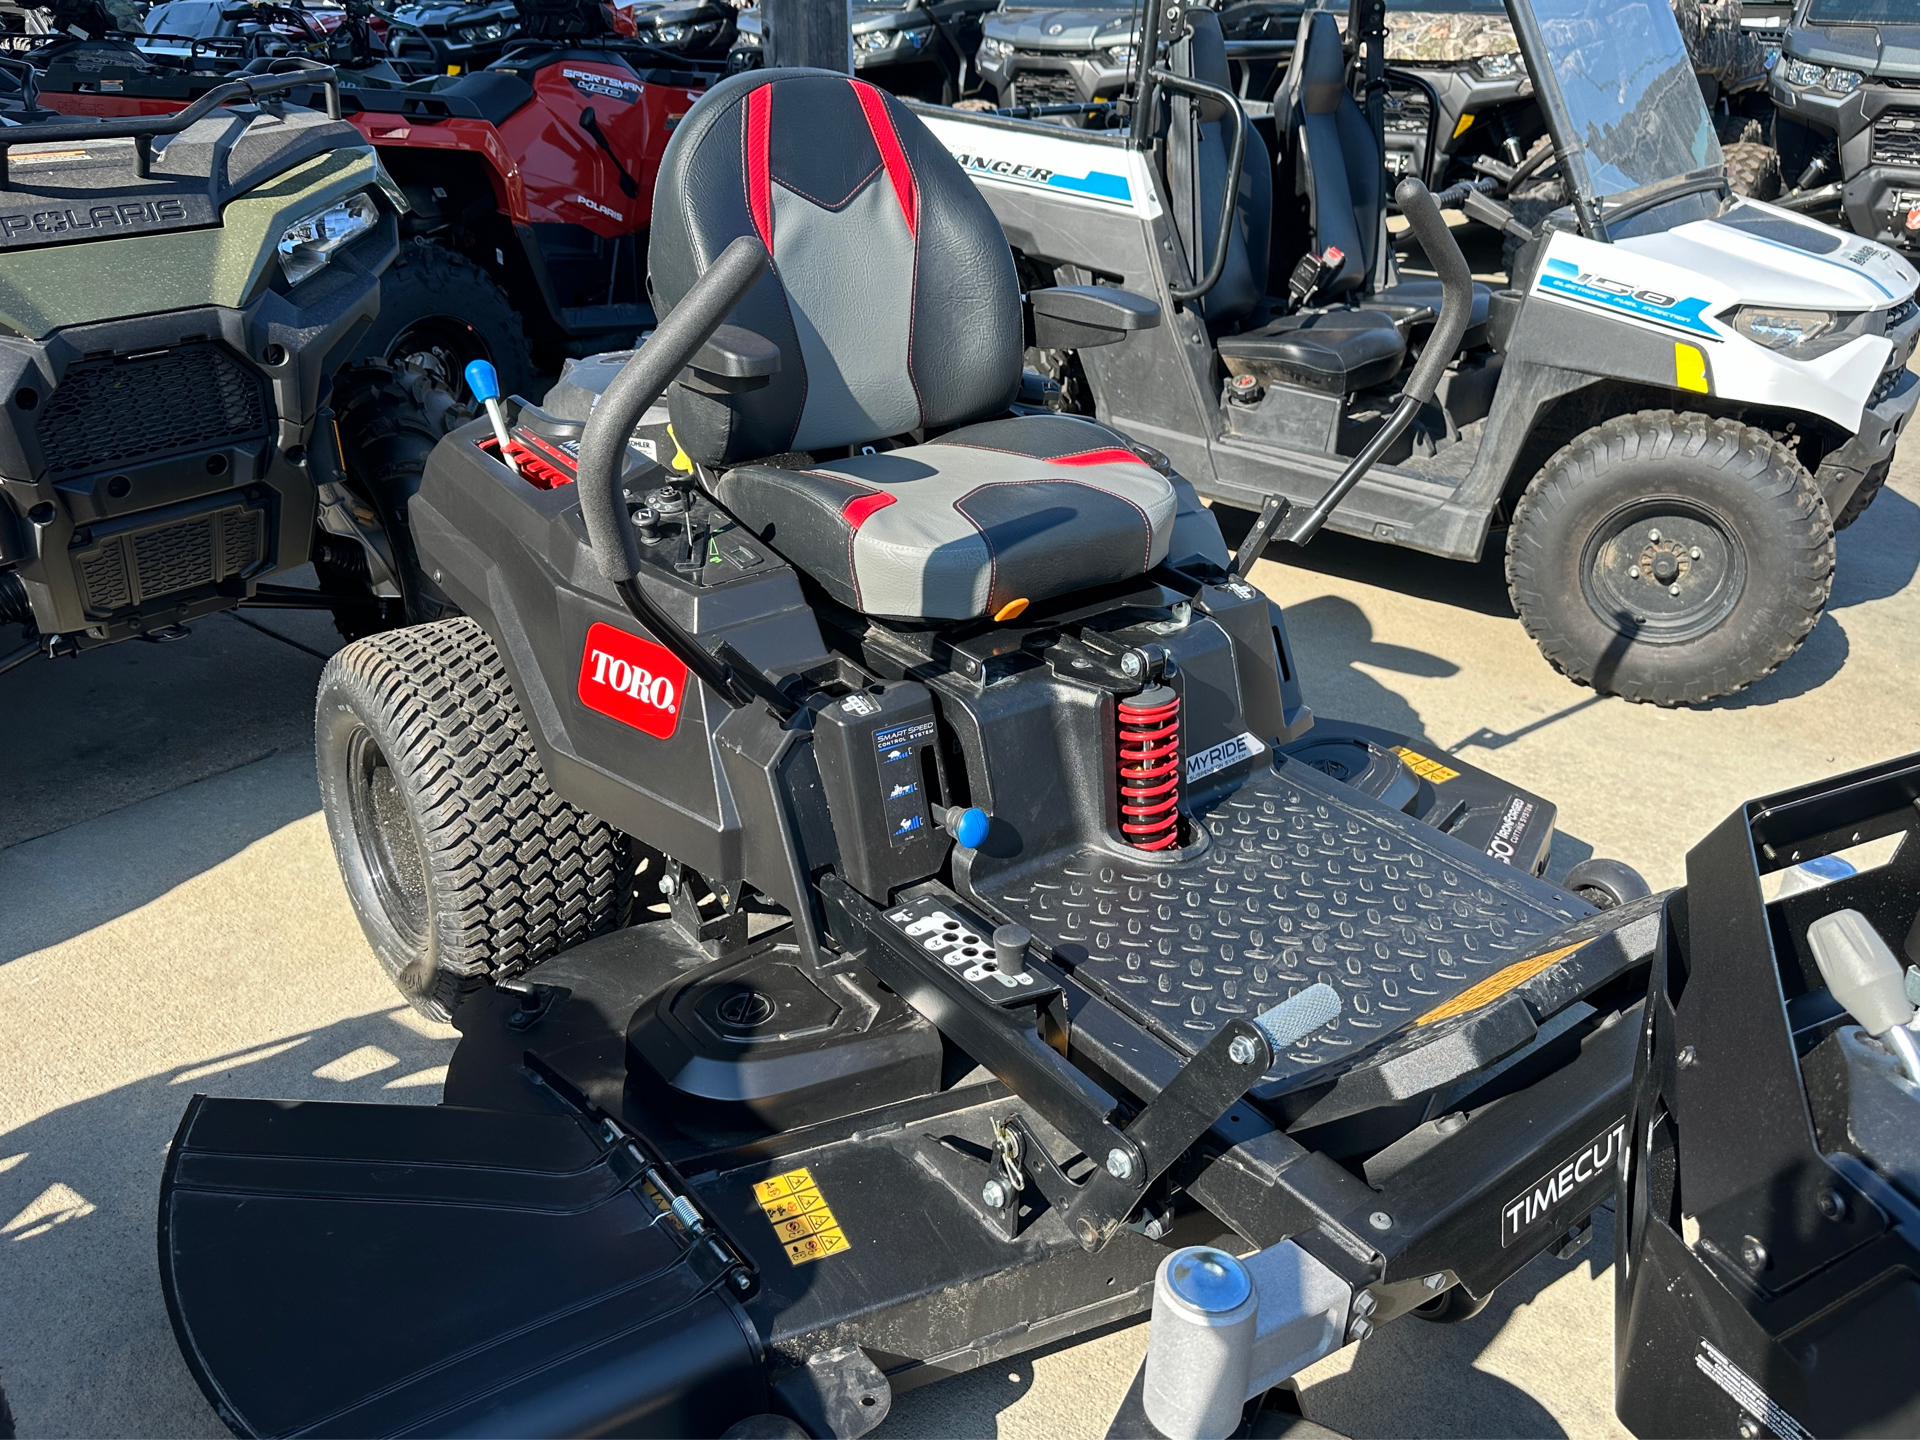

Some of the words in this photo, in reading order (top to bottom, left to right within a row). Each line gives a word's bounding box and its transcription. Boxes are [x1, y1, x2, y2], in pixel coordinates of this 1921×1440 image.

[562, 68, 644, 93] SPORTSMAN
[578, 80, 623, 98] 450
[951, 152, 1053, 182] ANGER
[1, 199, 187, 237] POLARIS
[577, 195, 624, 222] POLARIS
[1552, 279, 1609, 300] ELECTRONIC
[1613, 297, 1637, 309] FUEL
[1642, 306, 1691, 323] INJECTION
[1573, 272, 1679, 308] 150
[591, 648, 674, 709] TORO
[877, 728, 907, 743] SMART
[908, 721, 934, 735] SPEED
[877, 737, 906, 749] CONTROL
[910, 728, 934, 740] SYSTEM
[1189, 763, 1223, 781] SUSPENSION
[1224, 753, 1247, 766] SYSTEM
[1510, 821, 1525, 844] CUTTING
[1520, 803, 1533, 823] SYSTEM
[1506, 1123, 1625, 1234] TIMECUT
